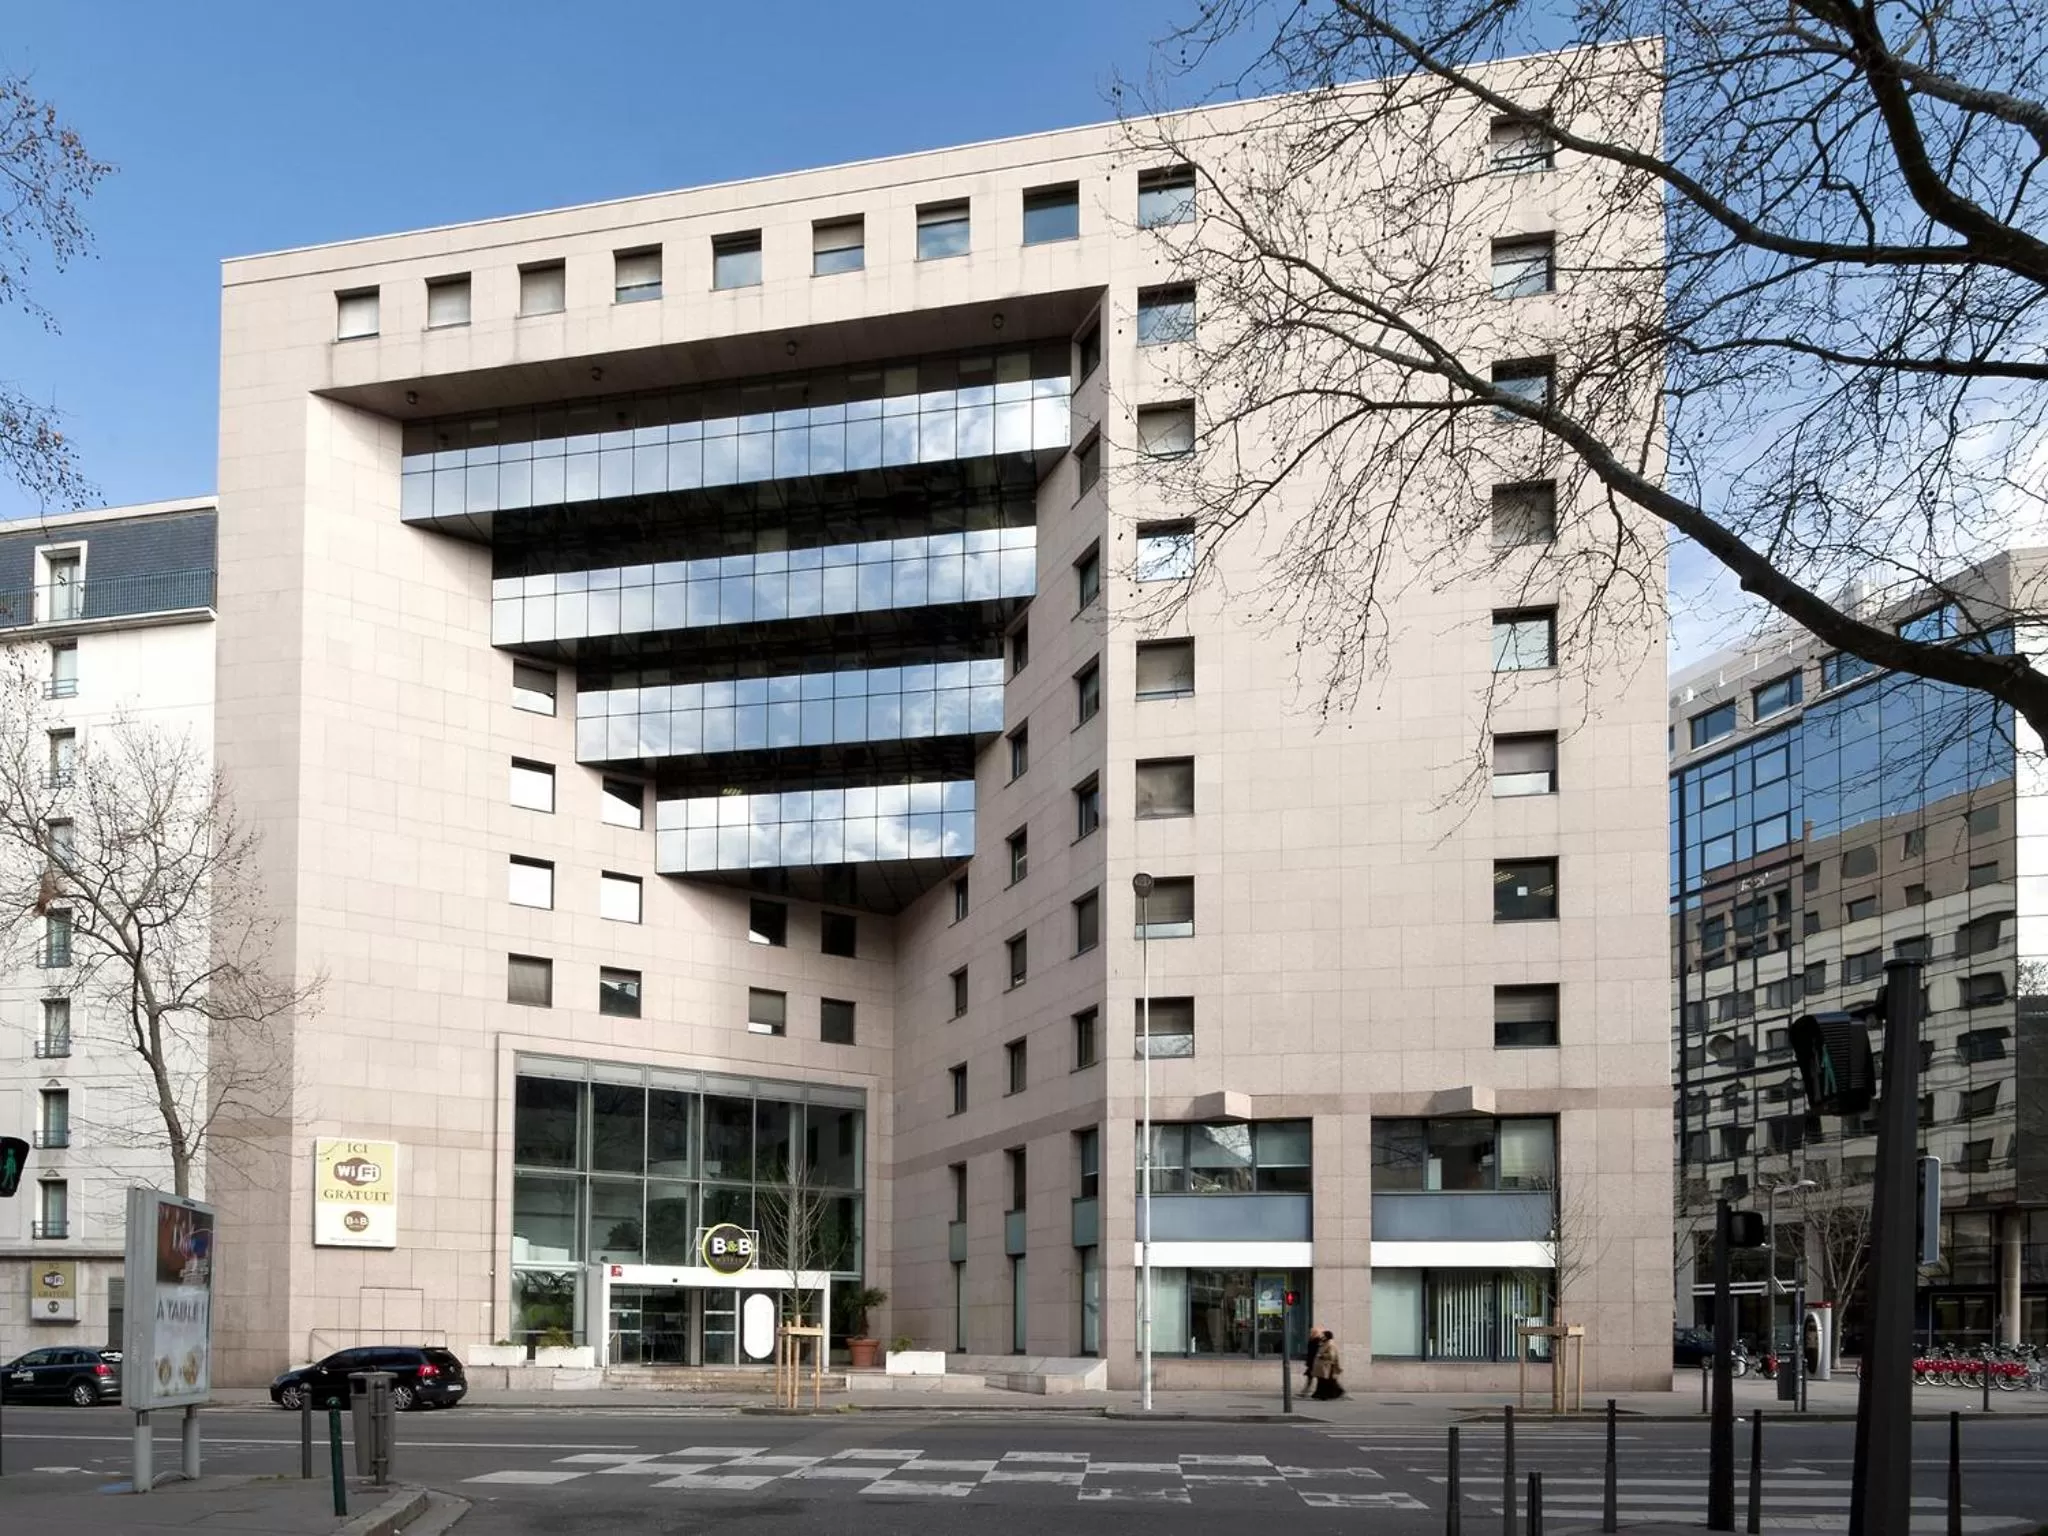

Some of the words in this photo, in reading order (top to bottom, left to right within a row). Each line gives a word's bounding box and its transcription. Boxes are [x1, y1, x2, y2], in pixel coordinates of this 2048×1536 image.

[347, 1143, 368, 1153] ICI
[323, 1189, 389, 1201] GRATUIT
[712, 1237, 752, 1254] B&B
